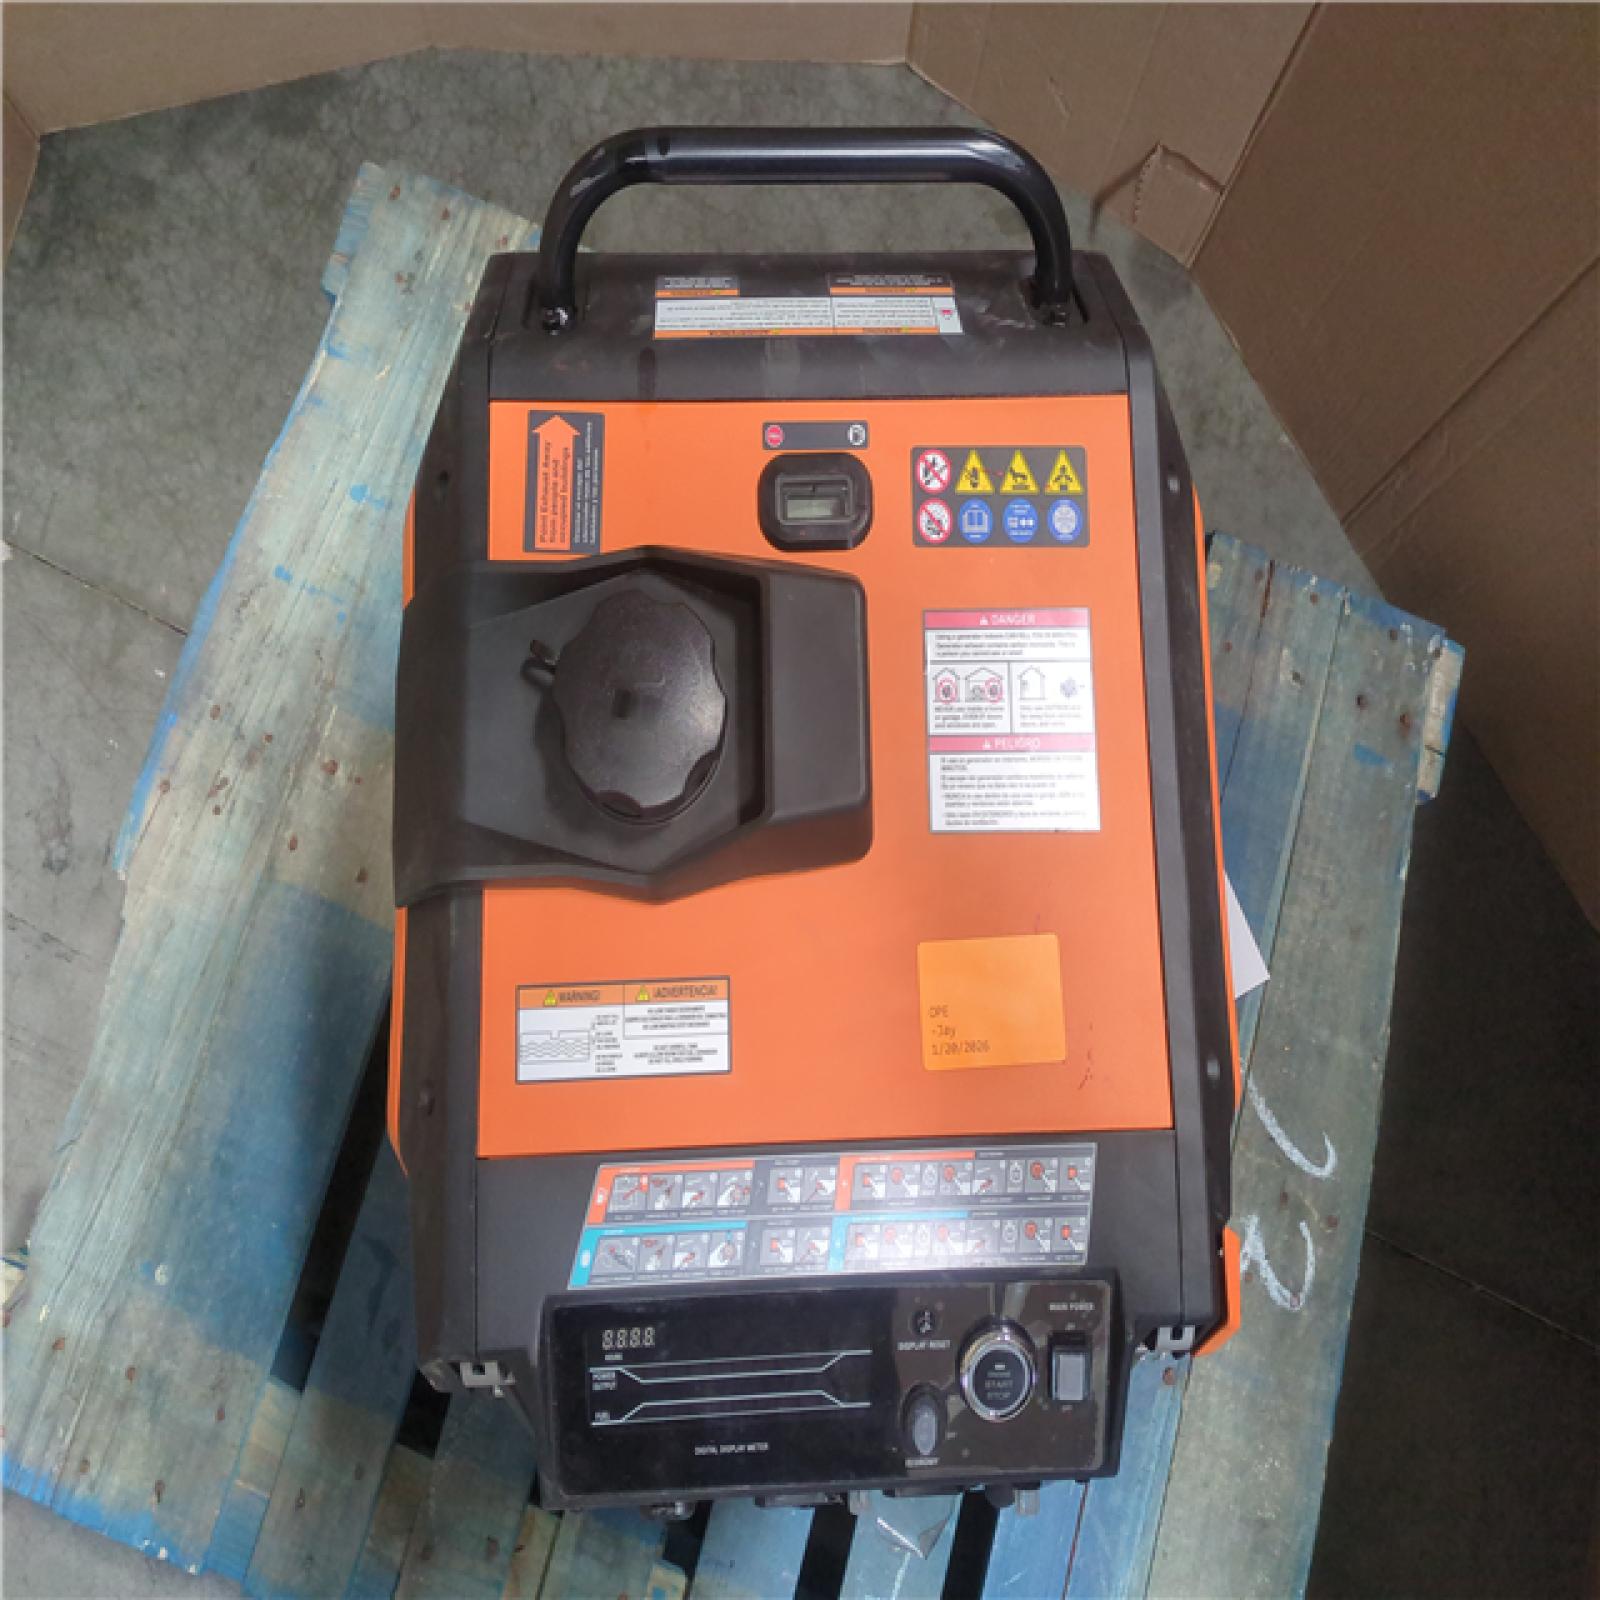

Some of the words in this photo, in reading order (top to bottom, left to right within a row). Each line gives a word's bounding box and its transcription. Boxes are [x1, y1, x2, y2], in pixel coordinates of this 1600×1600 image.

[991, 614, 1036, 624] DANGER
[994, 737, 1040, 749] PELIGRO
[1069, 1302, 1094, 1311] POWER
[985, 1379, 1013, 1388] START
[720, 1444, 745, 1453] DISPLAY
